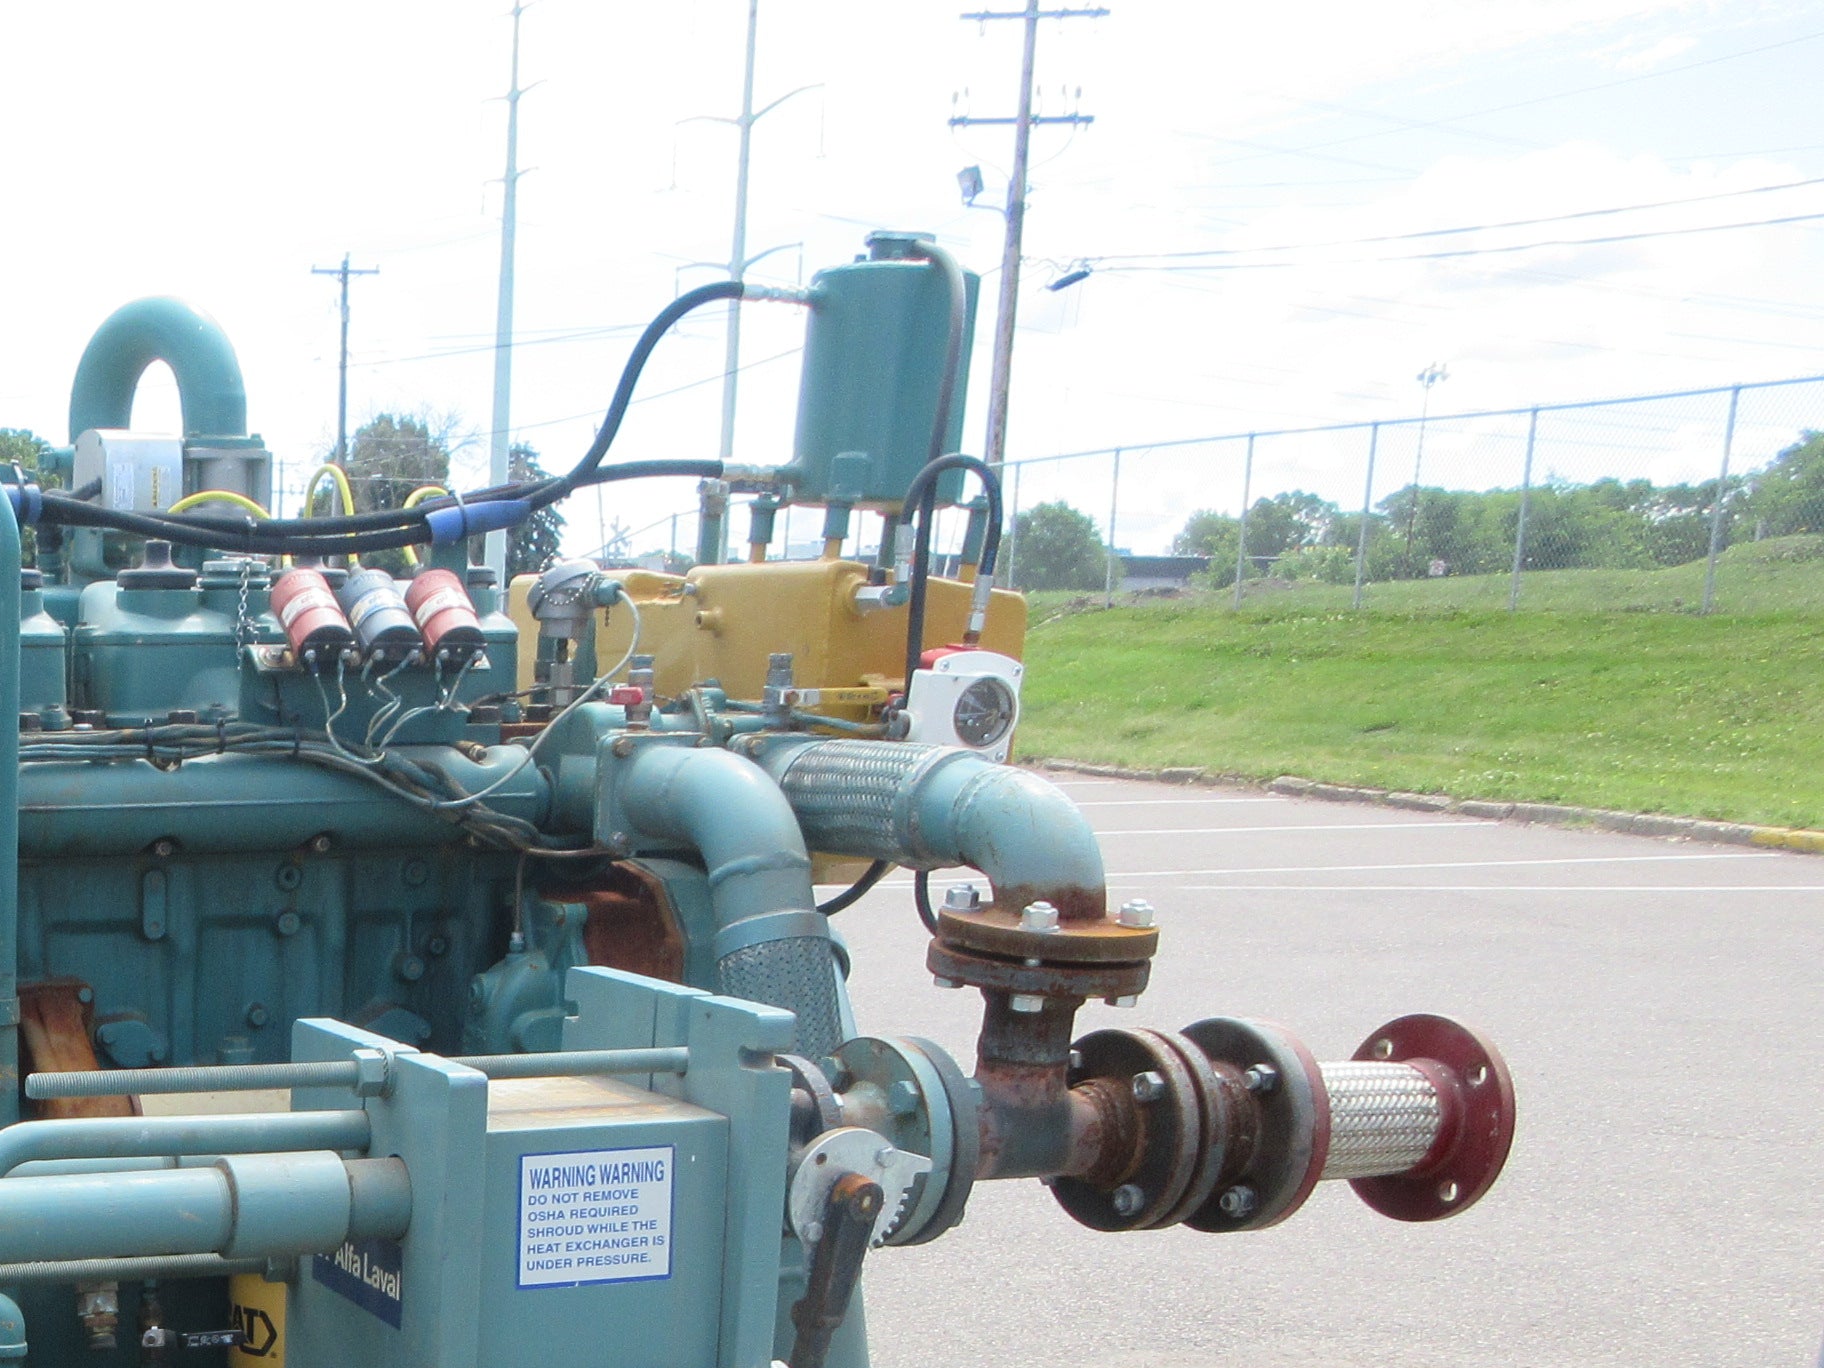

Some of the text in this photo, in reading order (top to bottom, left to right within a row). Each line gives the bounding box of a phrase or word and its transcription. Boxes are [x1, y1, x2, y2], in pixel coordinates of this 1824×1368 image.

[529, 1160, 665, 1190] WARNING WARNING
[528, 1188, 639, 1206] DO NOT REMOVE
[527, 1204, 639, 1222] OSHA REQUIRED
[527, 1219, 658, 1238] SHROUD WHILE THE
[527, 1235, 665, 1255] HEAT EXCHANGER IS
[526, 1252, 652, 1271] UNDER PRESSURE.
[334, 1242, 400, 1301] Alfa Laval
